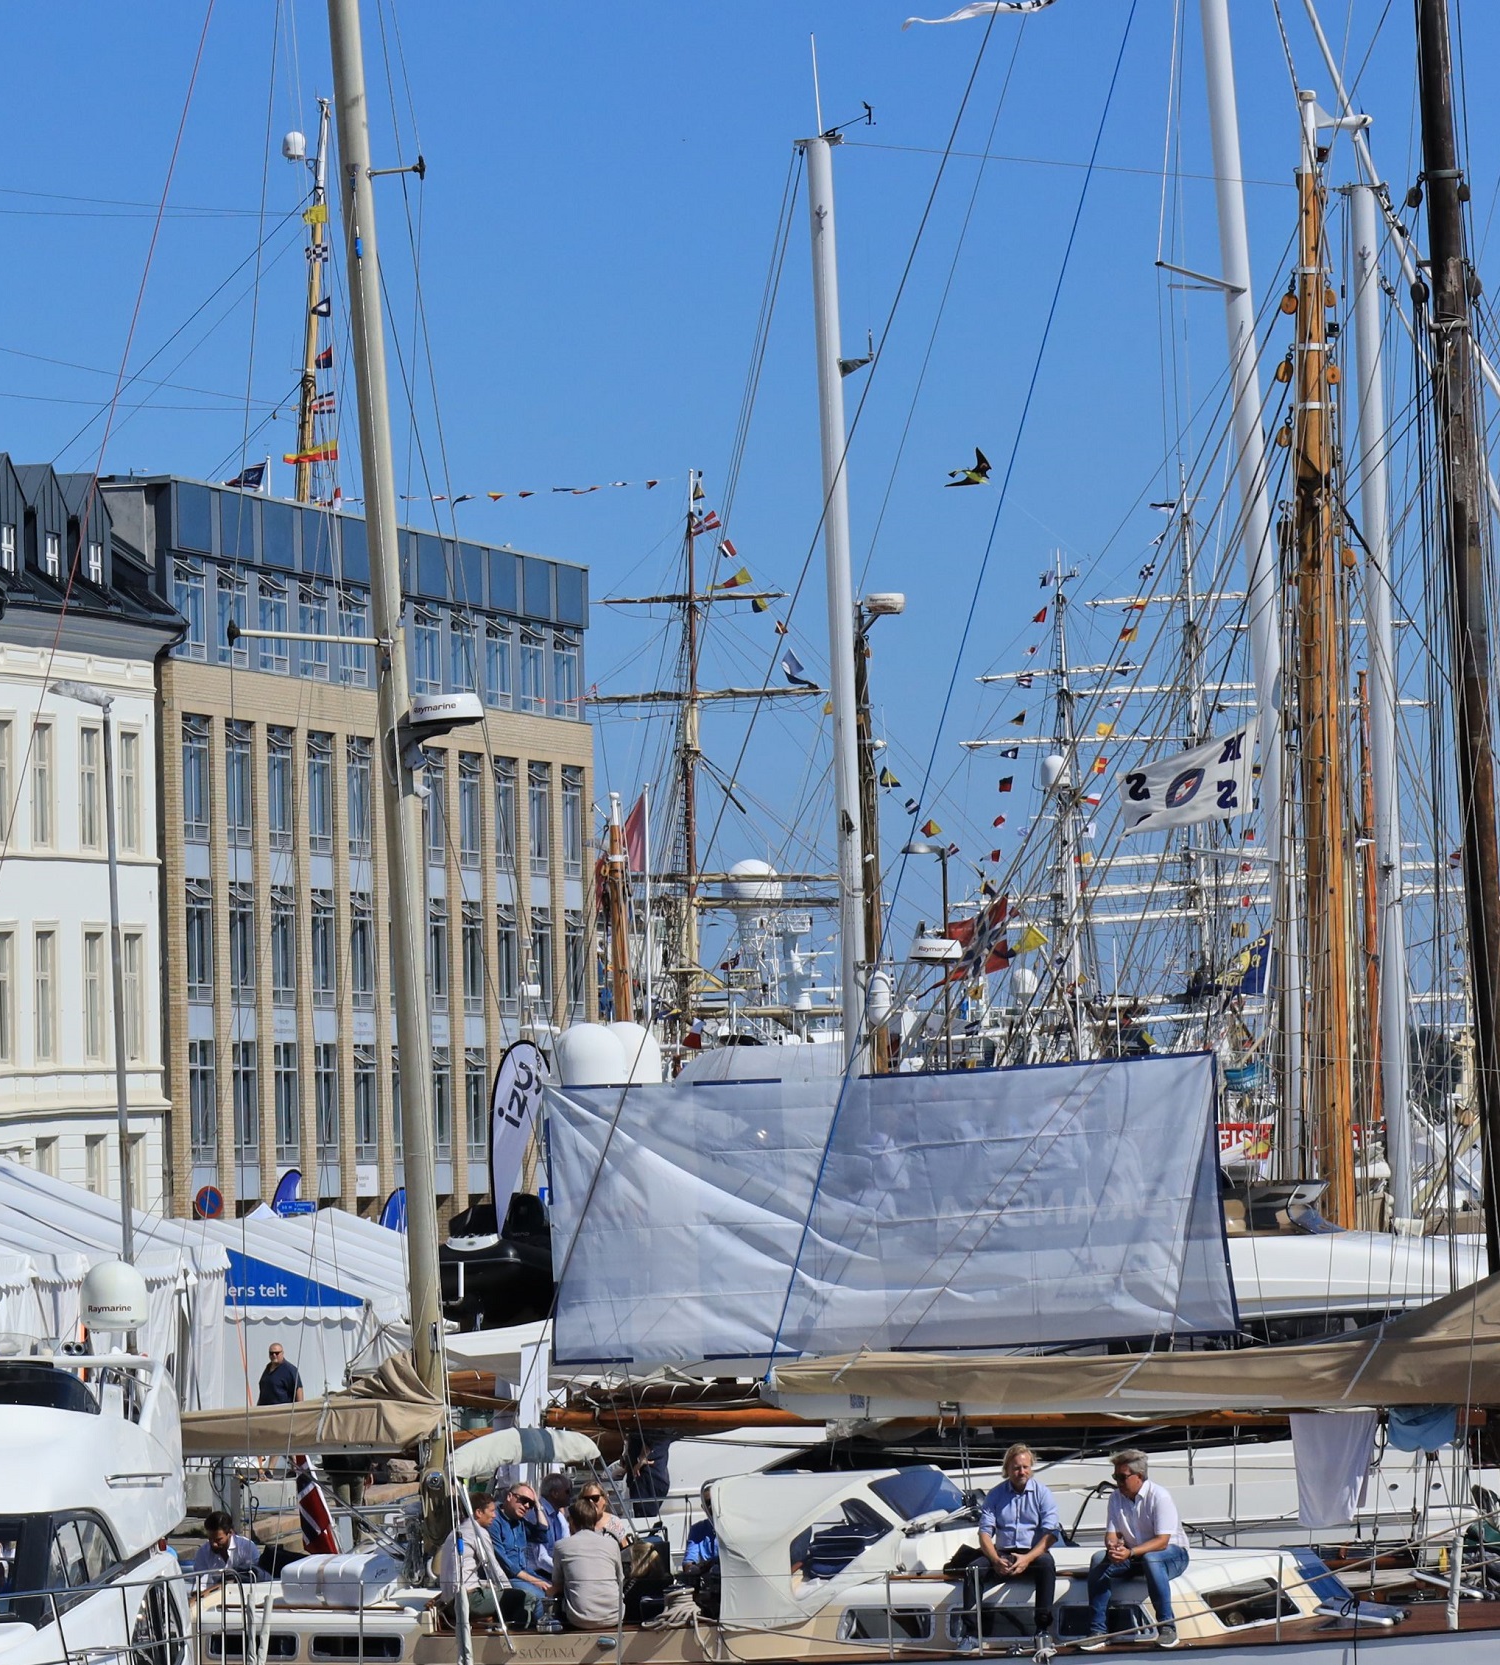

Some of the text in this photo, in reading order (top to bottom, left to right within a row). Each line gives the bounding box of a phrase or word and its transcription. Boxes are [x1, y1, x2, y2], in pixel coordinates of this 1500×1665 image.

[258, 1282, 288, 1298] telt
[87, 1303, 132, 1314] Raymarine
[519, 1647, 576, 1659] SANTANA
